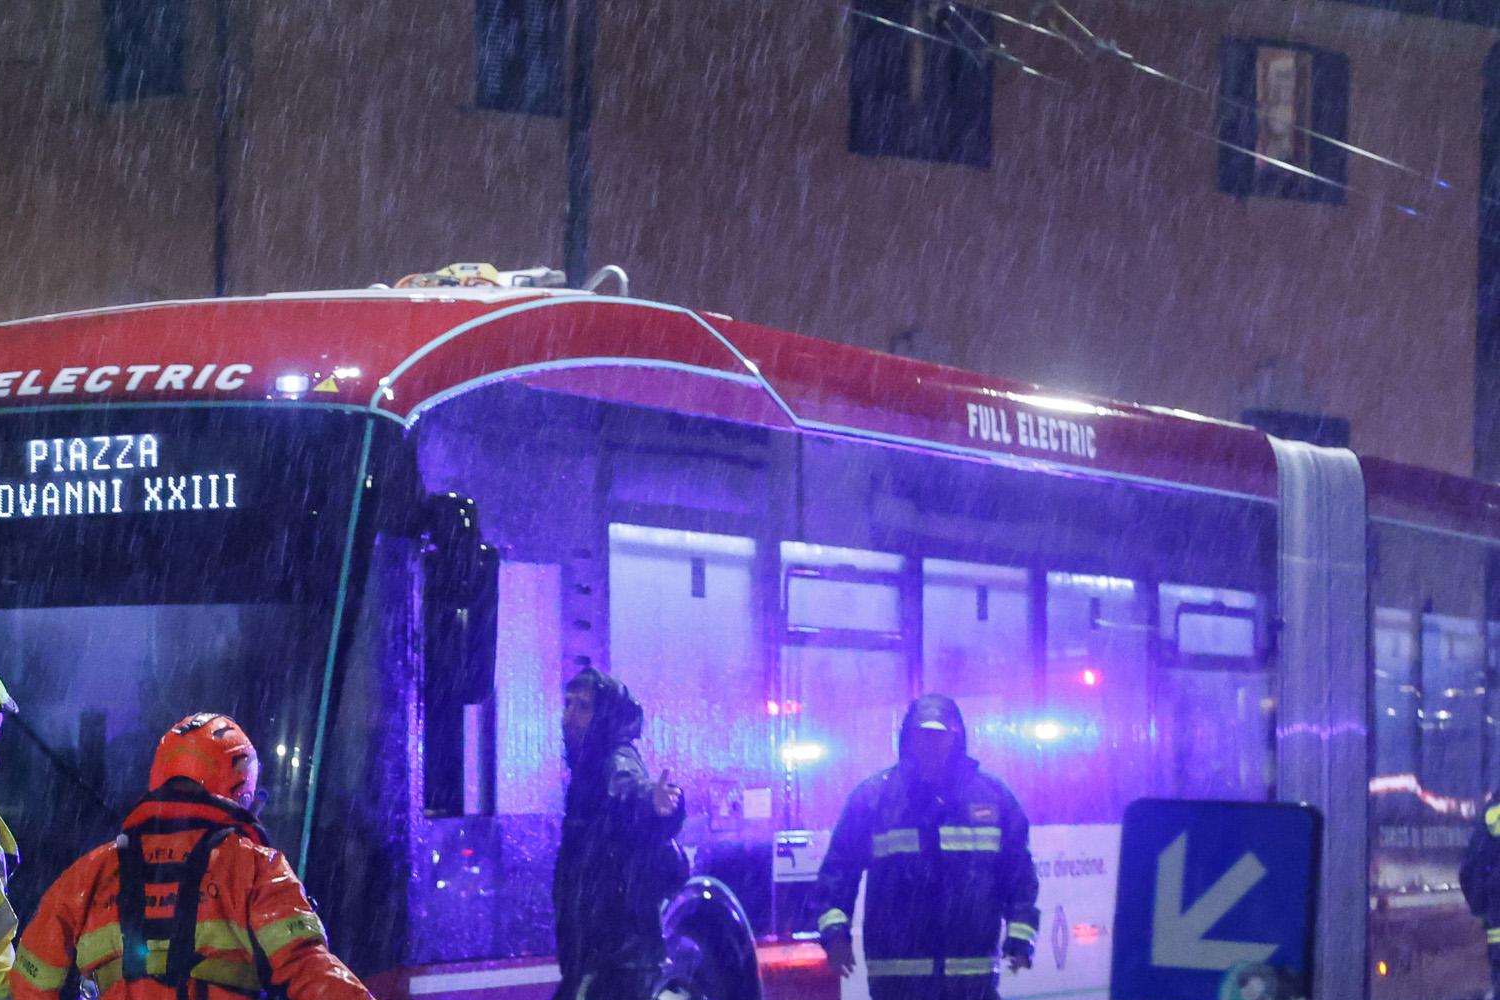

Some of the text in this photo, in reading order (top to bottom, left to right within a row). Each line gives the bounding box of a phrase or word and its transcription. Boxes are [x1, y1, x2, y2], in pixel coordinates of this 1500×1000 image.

[967, 403, 1097, 459] FULL ELECTRIC
[28, 434, 159, 472] PIAZZA
[143, 473, 238, 510] XXIII
